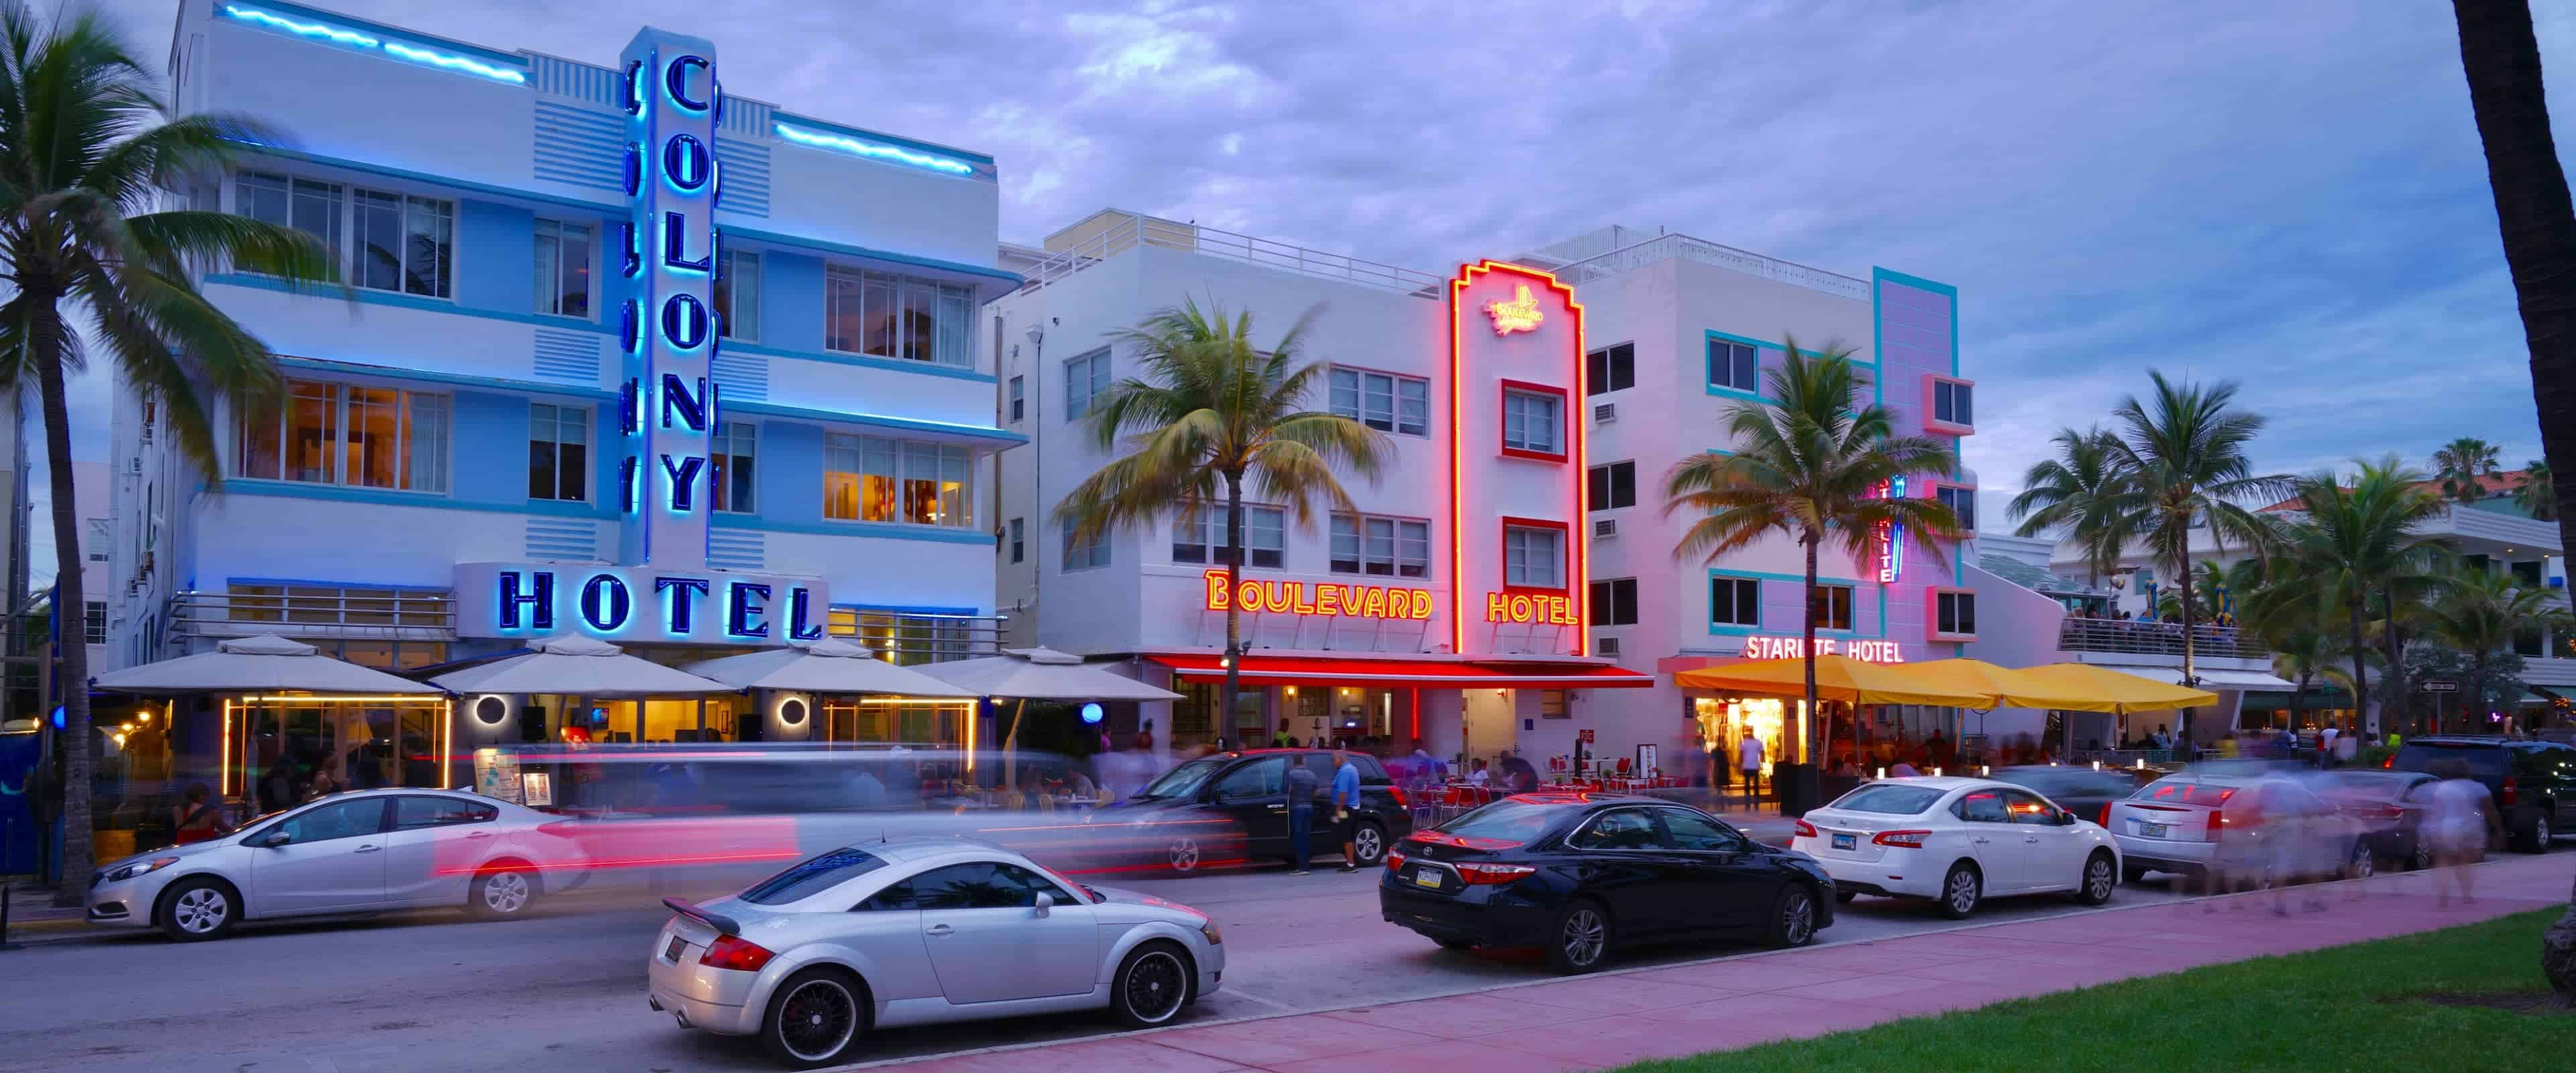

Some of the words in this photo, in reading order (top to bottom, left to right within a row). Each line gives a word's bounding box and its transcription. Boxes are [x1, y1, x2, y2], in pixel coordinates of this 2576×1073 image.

[661, 55, 710, 511] COLONY
[500, 571, 822, 640] HOTEL
[1205, 569, 1433, 620] BOULEVARD
[1487, 591, 1578, 625] HOTEL
[1747, 636, 1835, 660] STARLTE
[1848, 640, 1904, 663] HOTEL
